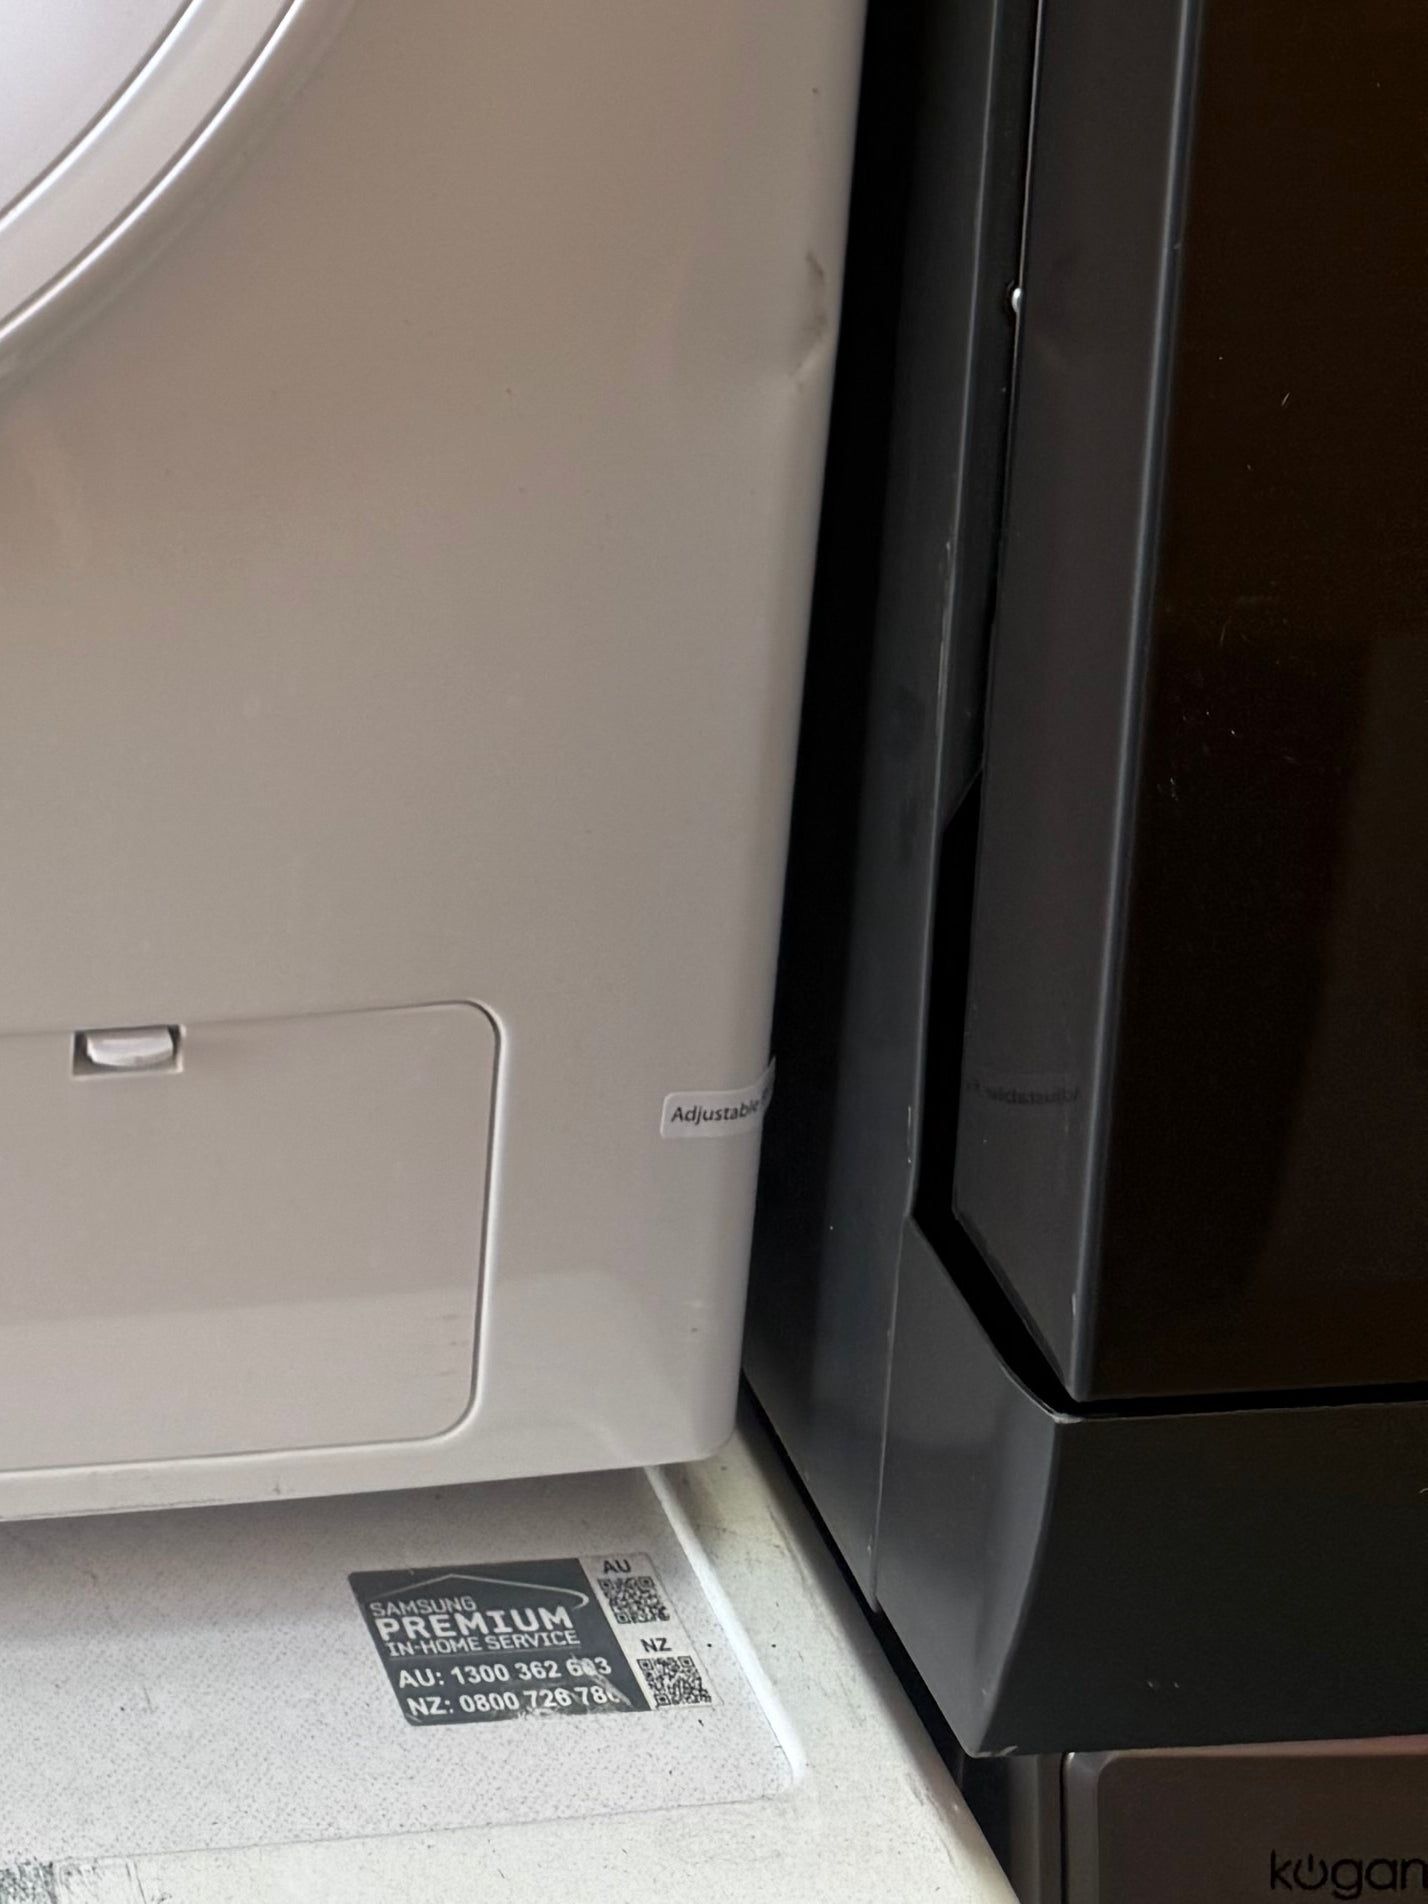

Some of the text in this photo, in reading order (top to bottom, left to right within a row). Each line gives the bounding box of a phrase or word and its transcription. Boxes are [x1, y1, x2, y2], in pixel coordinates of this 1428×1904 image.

[604, 1559, 631, 1574] AU
[369, 1595, 477, 1617] SAMSUNG
[376, 1606, 575, 1641] PREMIUM
[387, 1631, 580, 1656] IN-HOME SERVICE
[641, 1638, 671, 1652] NZ
[400, 1669, 444, 1688] AU:
[451, 1664, 510, 1684] 1300
[515, 1661, 561, 1680] 362
[406, 1696, 453, 1716] NZ:
[461, 1693, 520, 1713] 0800
